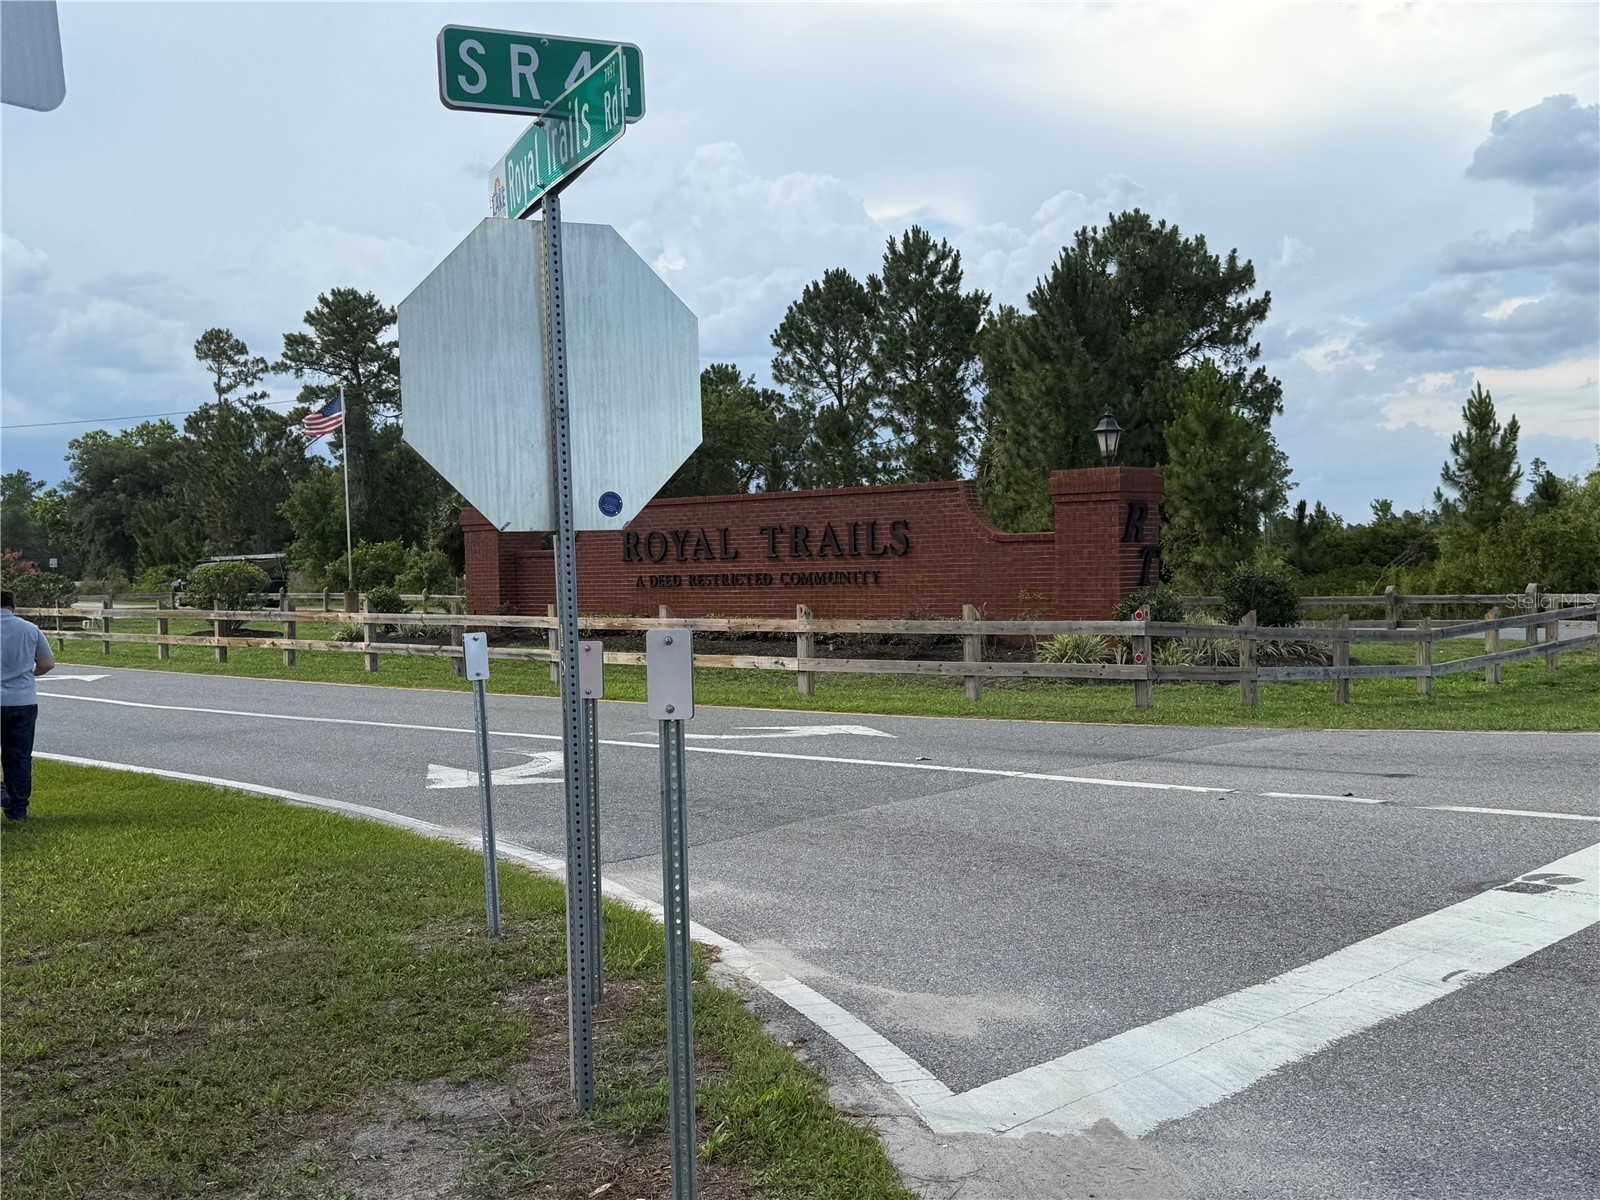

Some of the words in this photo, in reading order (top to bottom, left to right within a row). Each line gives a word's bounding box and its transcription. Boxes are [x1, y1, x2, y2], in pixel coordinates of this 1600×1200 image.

[457, 38, 488, 95] S
[509, 43, 541, 100] R
[507, 131, 541, 212] Royal
[543, 96, 592, 176] Trails
[604, 83, 619, 133] Rd
[622, 527, 739, 562] ROYAL
[759, 519, 910, 559] TRAILS
[1120, 501, 1149, 543] R
[636, 575, 646, 588] A
[648, 574, 683, 588] DEED
[687, 572, 773, 587] RESTRICTED
[780, 570, 881, 586] COMMUNITY
